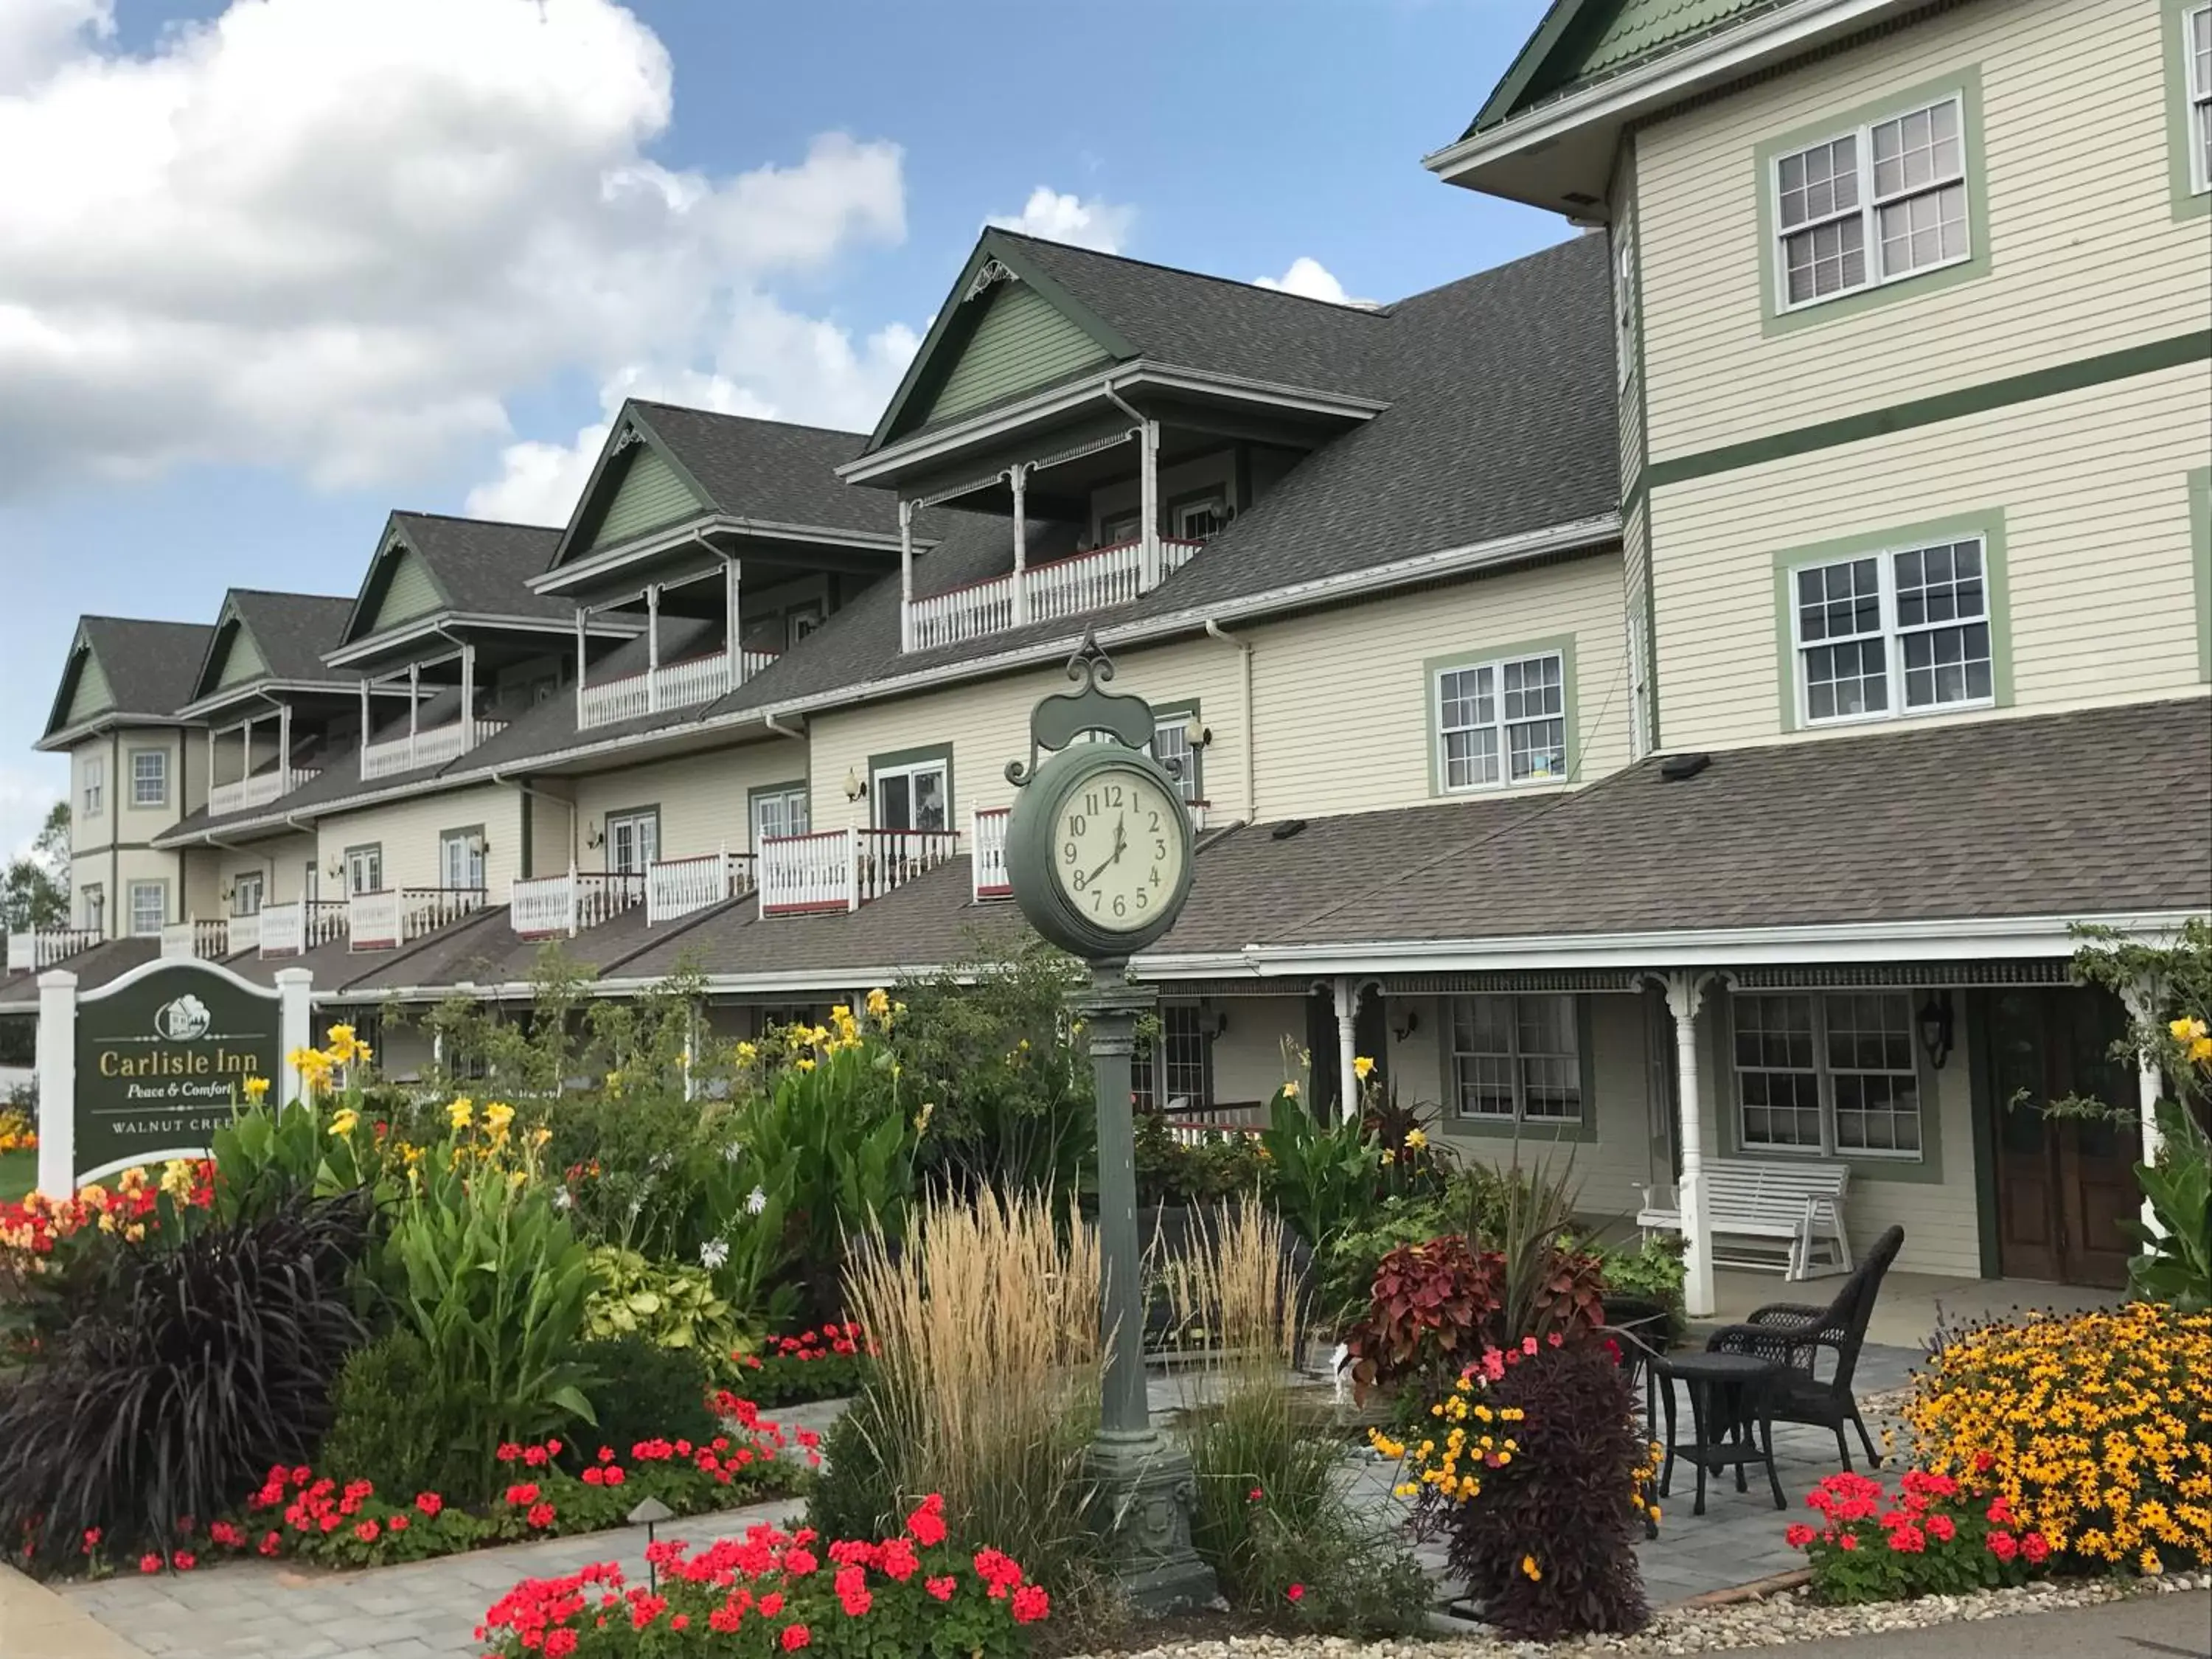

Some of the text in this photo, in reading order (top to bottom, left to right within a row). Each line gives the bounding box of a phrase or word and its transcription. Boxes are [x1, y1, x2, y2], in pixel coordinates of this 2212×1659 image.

[1085, 794, 1099, 815] 11
[1104, 786, 1123, 807] 12
[1132, 792, 1140, 813] 1
[1069, 815, 1086, 837] 10
[1148, 811, 1160, 832] 2
[1064, 843, 1077, 864] 9
[1155, 839, 1166, 860] 3
[1073, 869, 1085, 891] 8
[1149, 865, 1161, 887] 4
[1091, 890, 1102, 911] 7
[1113, 894, 1126, 917] 6
[1136, 888, 1148, 908] 5
[99, 1048, 258, 1077] Carlisle Inn
[127, 1080, 232, 1099] Peace & Comfort
[112, 1116, 232, 1134] WALNUT CREE
